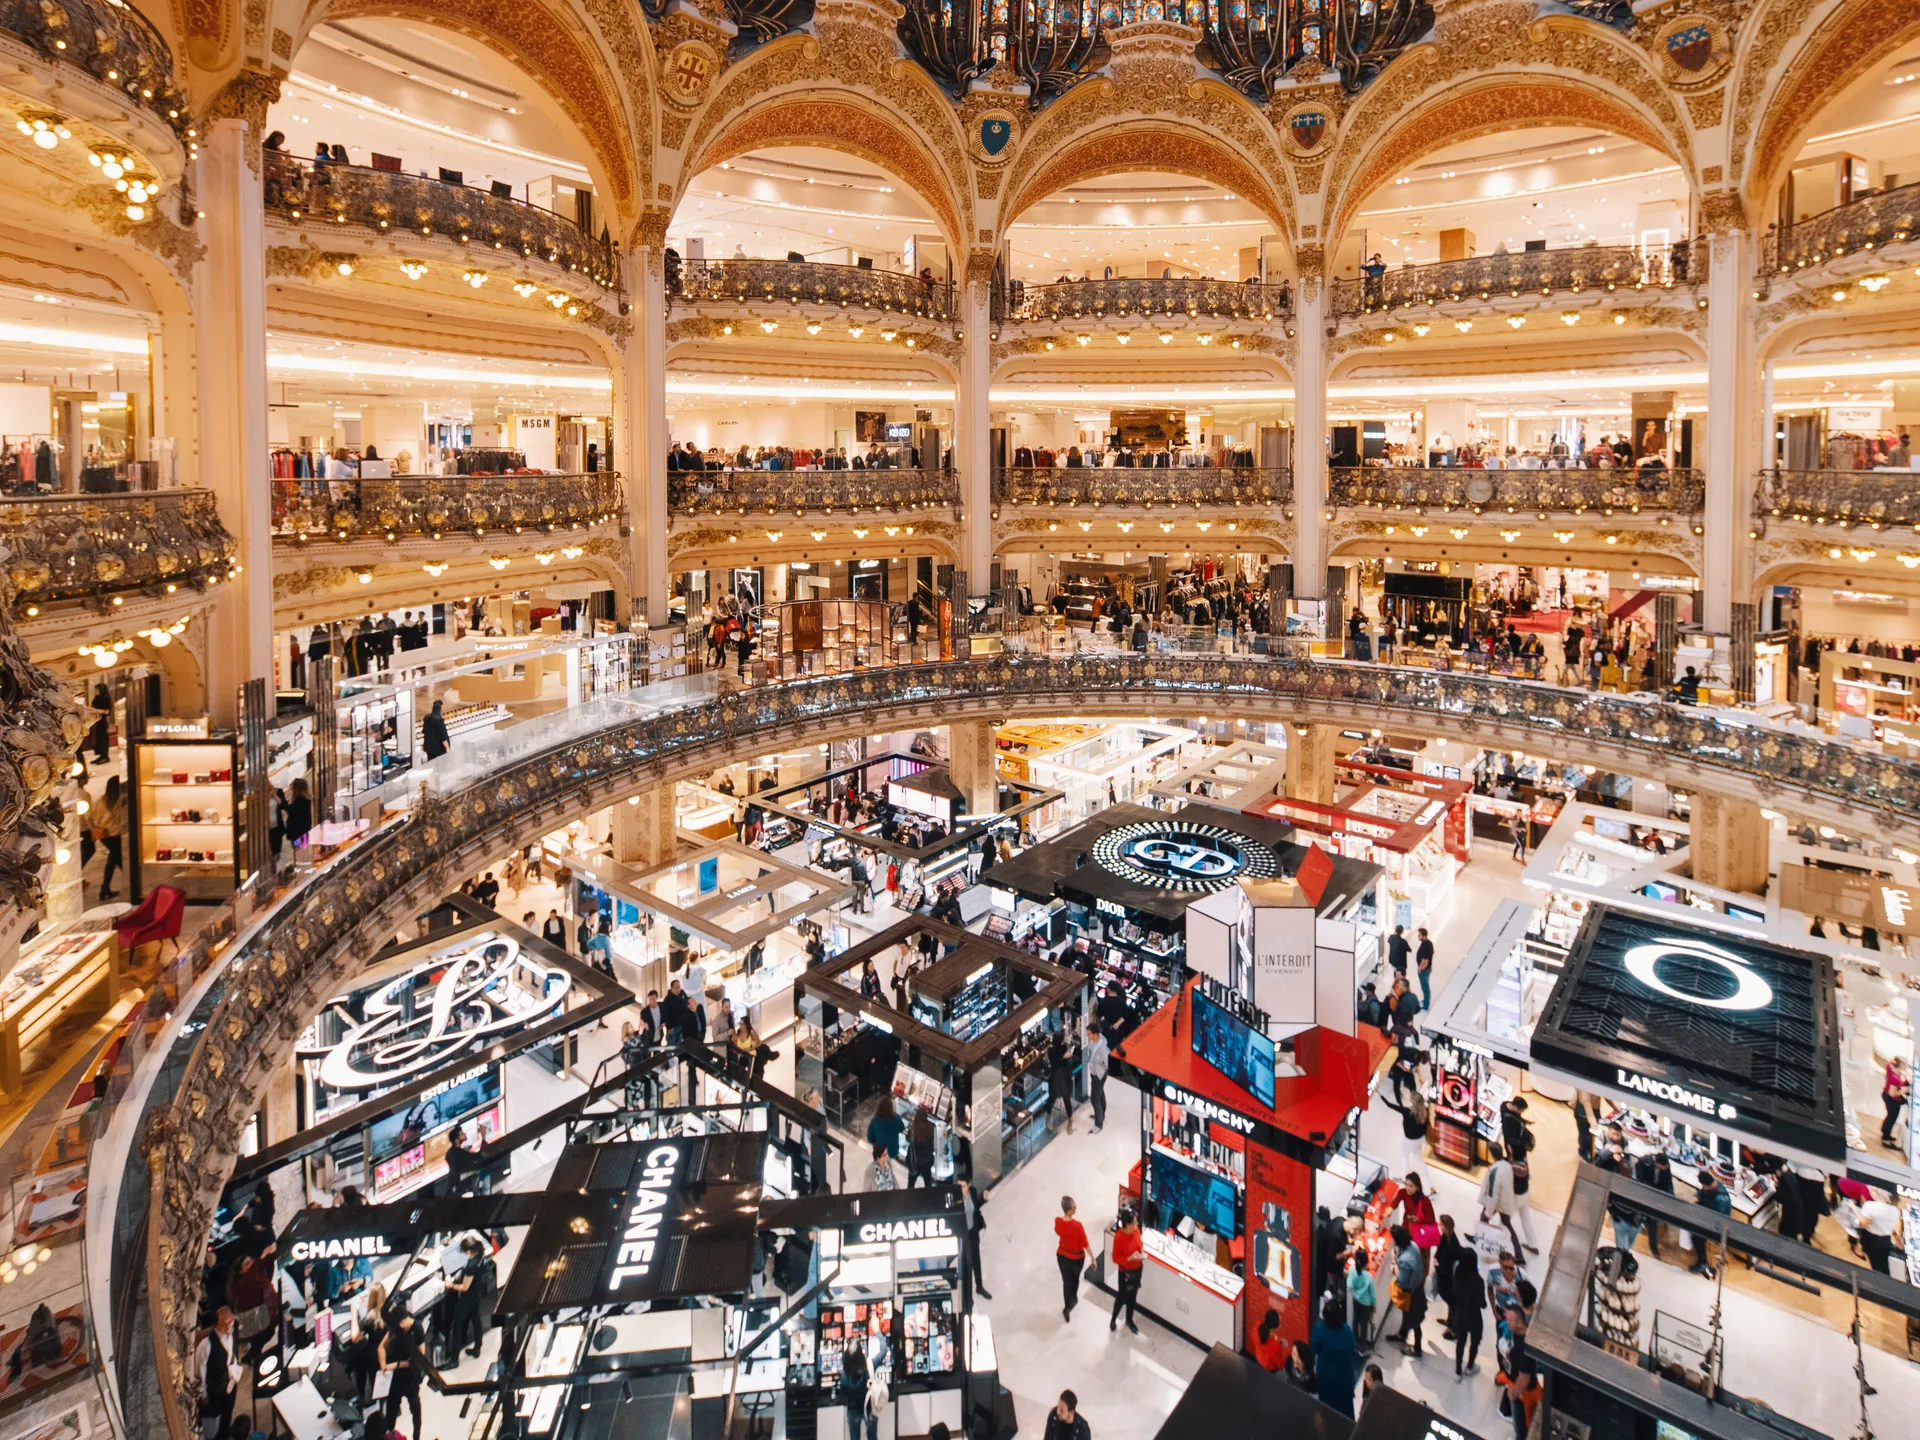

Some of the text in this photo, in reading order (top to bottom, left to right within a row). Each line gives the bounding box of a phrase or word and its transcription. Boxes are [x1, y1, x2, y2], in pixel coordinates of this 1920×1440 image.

[521, 418, 551, 428] MSGM
[888, 428, 910, 438] KENZO
[152, 724, 202, 734] BVLGARI
[1095, 897, 1127, 919] DIOR
[1256, 954, 1313, 968] L'INTERDIT
[450, 1063, 488, 1089] LAUDER
[1163, 1084, 1256, 1135] GIVENCHY
[607, 1145, 680, 1292] CHANEL
[859, 1217, 953, 1243] CHANEL
[290, 1235, 391, 1261] CHANEL
